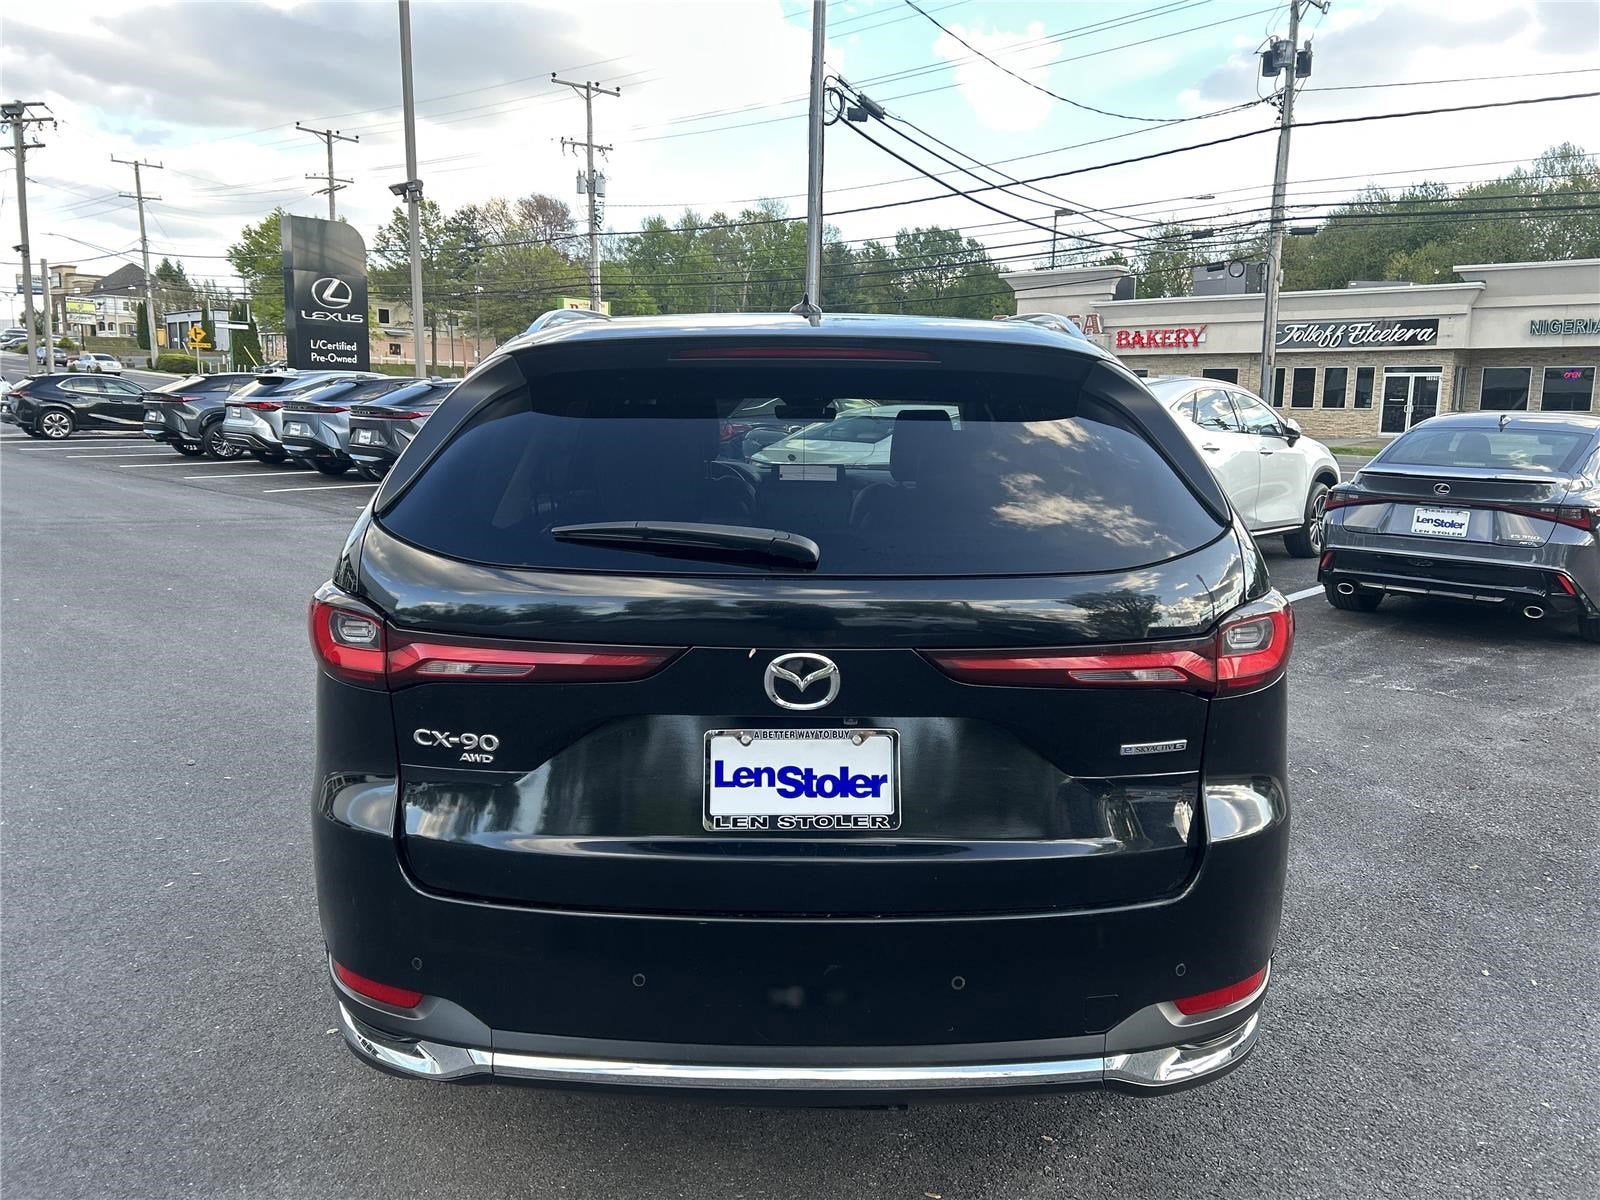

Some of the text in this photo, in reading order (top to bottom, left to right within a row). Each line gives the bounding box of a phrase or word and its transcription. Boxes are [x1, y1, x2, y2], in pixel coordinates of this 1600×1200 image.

[301, 310, 364, 323] LEXUS
[1116, 324, 1207, 349] BAKERY
[1348, 322, 1437, 345] Etcetera
[310, 339, 357, 351] L/Certified
[311, 352, 358, 364] Pre-Owned
[1563, 371, 1582, 379] OPEN
[412, 728, 499, 751] CX-90
[754, 730, 850, 739] A BETTER WAY TO BUY
[460, 752, 494, 763] AWD
[713, 815, 891, 829] LEN STOLER
